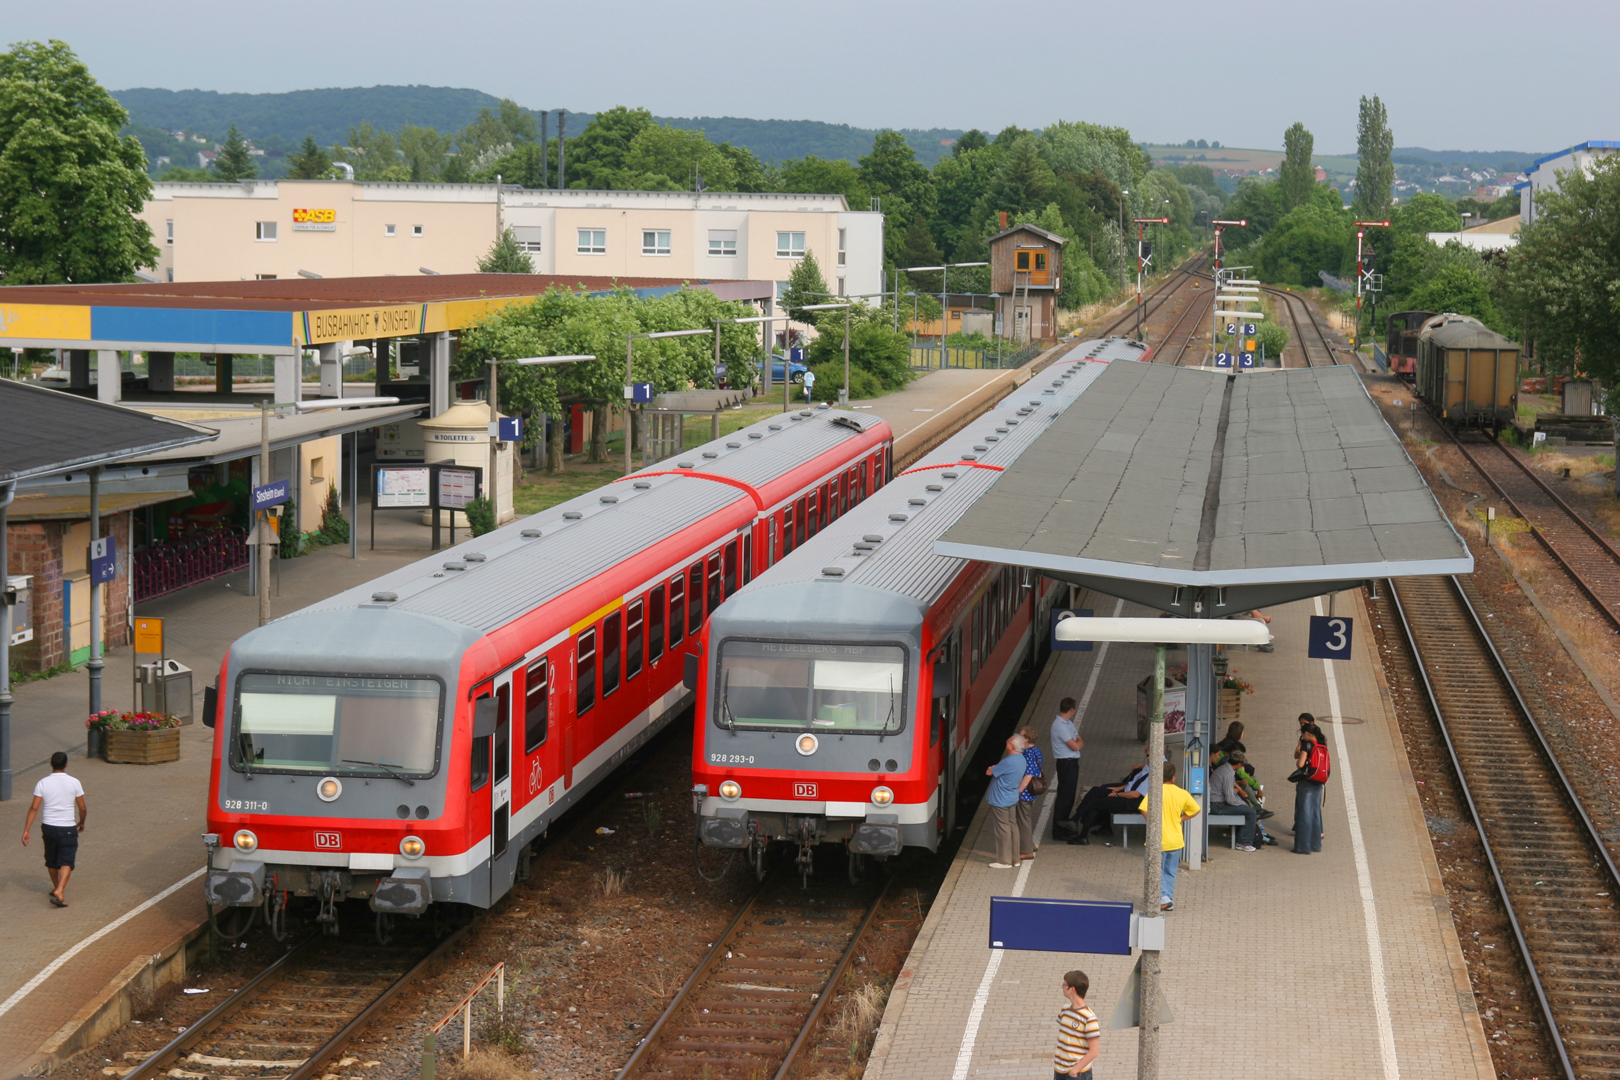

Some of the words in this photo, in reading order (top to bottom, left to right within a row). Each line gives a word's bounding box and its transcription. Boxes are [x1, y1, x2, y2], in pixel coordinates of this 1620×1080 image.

[303, 209, 336, 222] ASB
[316, 314, 370, 338] BUSBAHNHOF
[382, 310, 416, 332] SINSHEIM
[1228, 324, 1235, 333] 2
[1248, 324, 1255, 334] 3
[798, 348, 804, 360] 1
[1218, 353, 1226, 365] 2
[1244, 354, 1252, 366] 3
[643, 384, 650, 398] 1
[511, 418, 519, 436] 1
[256, 488, 274, 503] Sinsheim
[1325, 619, 1346, 651] 3
[762, 643, 837, 654] HEIDELBERG
[569, 652, 574, 681] 1
[277, 675, 316, 686] NICHT
[326, 676, 408, 688] EINSTEIGEN
[550, 664, 556, 695] 2
[711, 754, 727, 762] 928
[729, 755, 755, 764] 293-0
[796, 784, 816, 796] DB
[225, 800, 242, 809] 928
[244, 802, 268, 810] 311-0
[318, 834, 338, 846] DB
